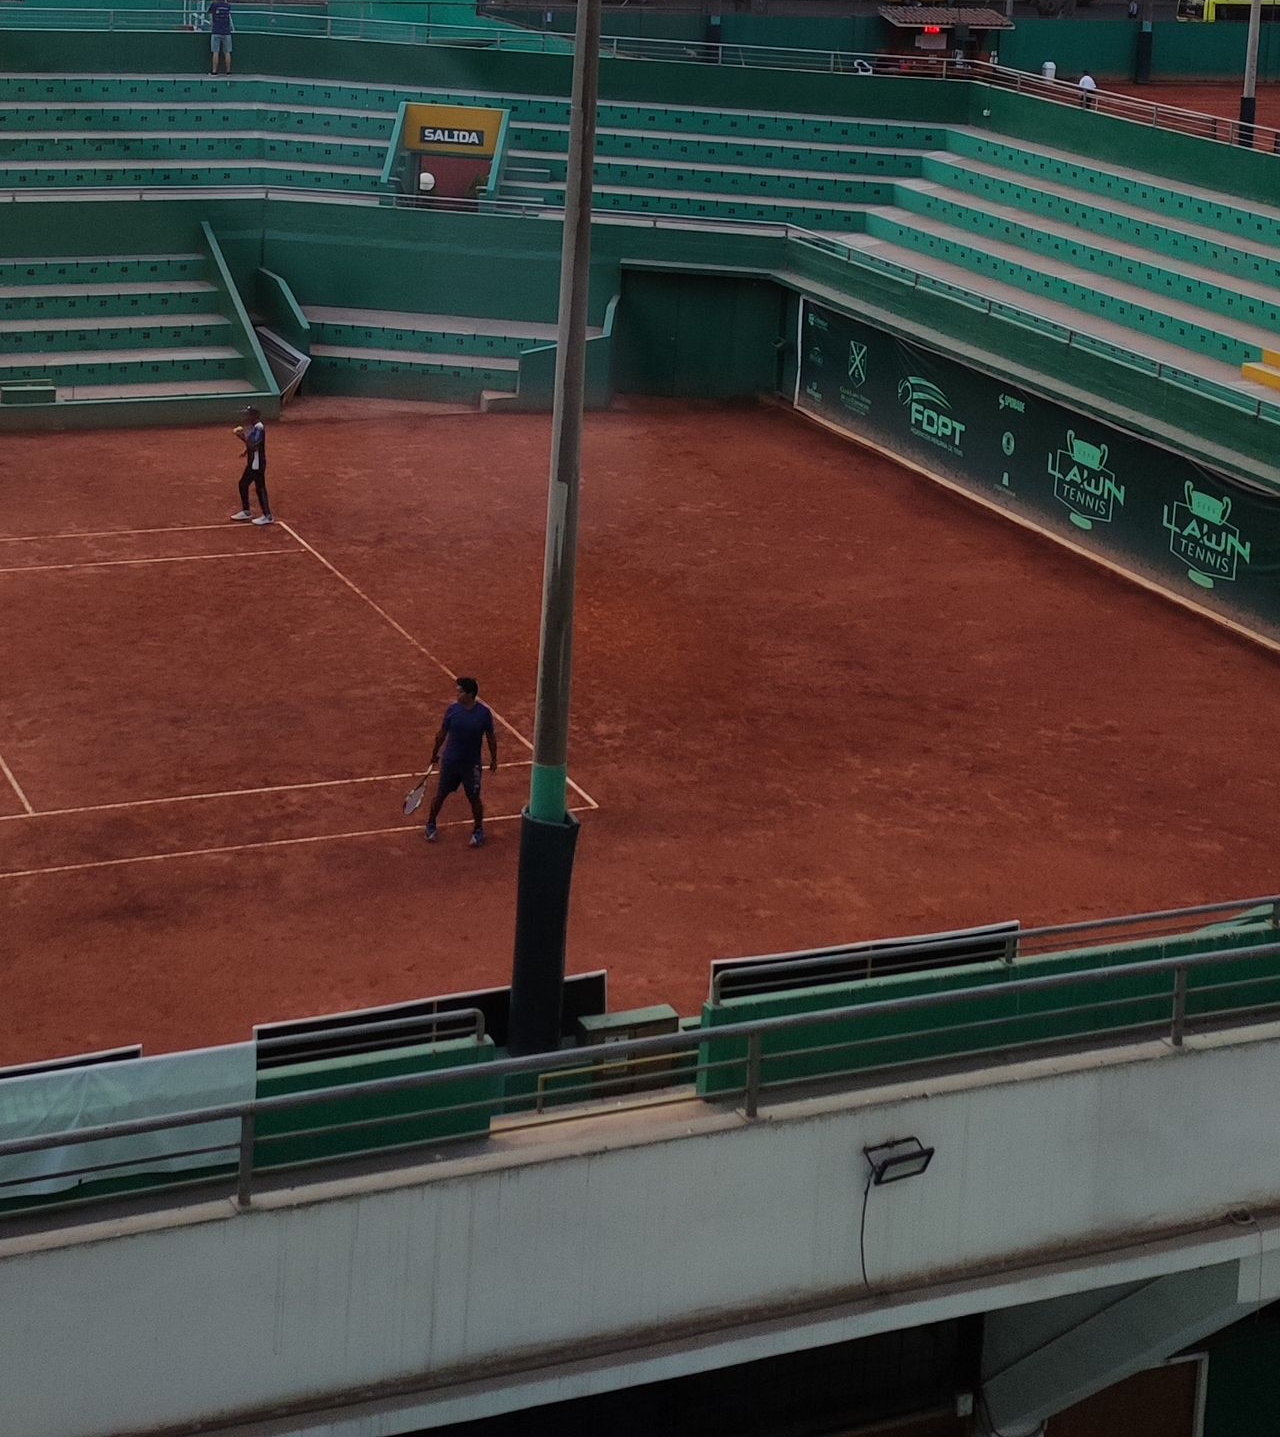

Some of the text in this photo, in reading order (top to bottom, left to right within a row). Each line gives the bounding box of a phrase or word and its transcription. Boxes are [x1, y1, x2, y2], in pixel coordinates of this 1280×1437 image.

[424, 129, 480, 144] SALIDA
[910, 401, 966, 446] FDPT
[1047, 451, 1126, 507] LAWN
[1062, 483, 1107, 516] TENNIS
[1162, 504, 1252, 565] LAWN
[1180, 538, 1230, 573] TENNIS
